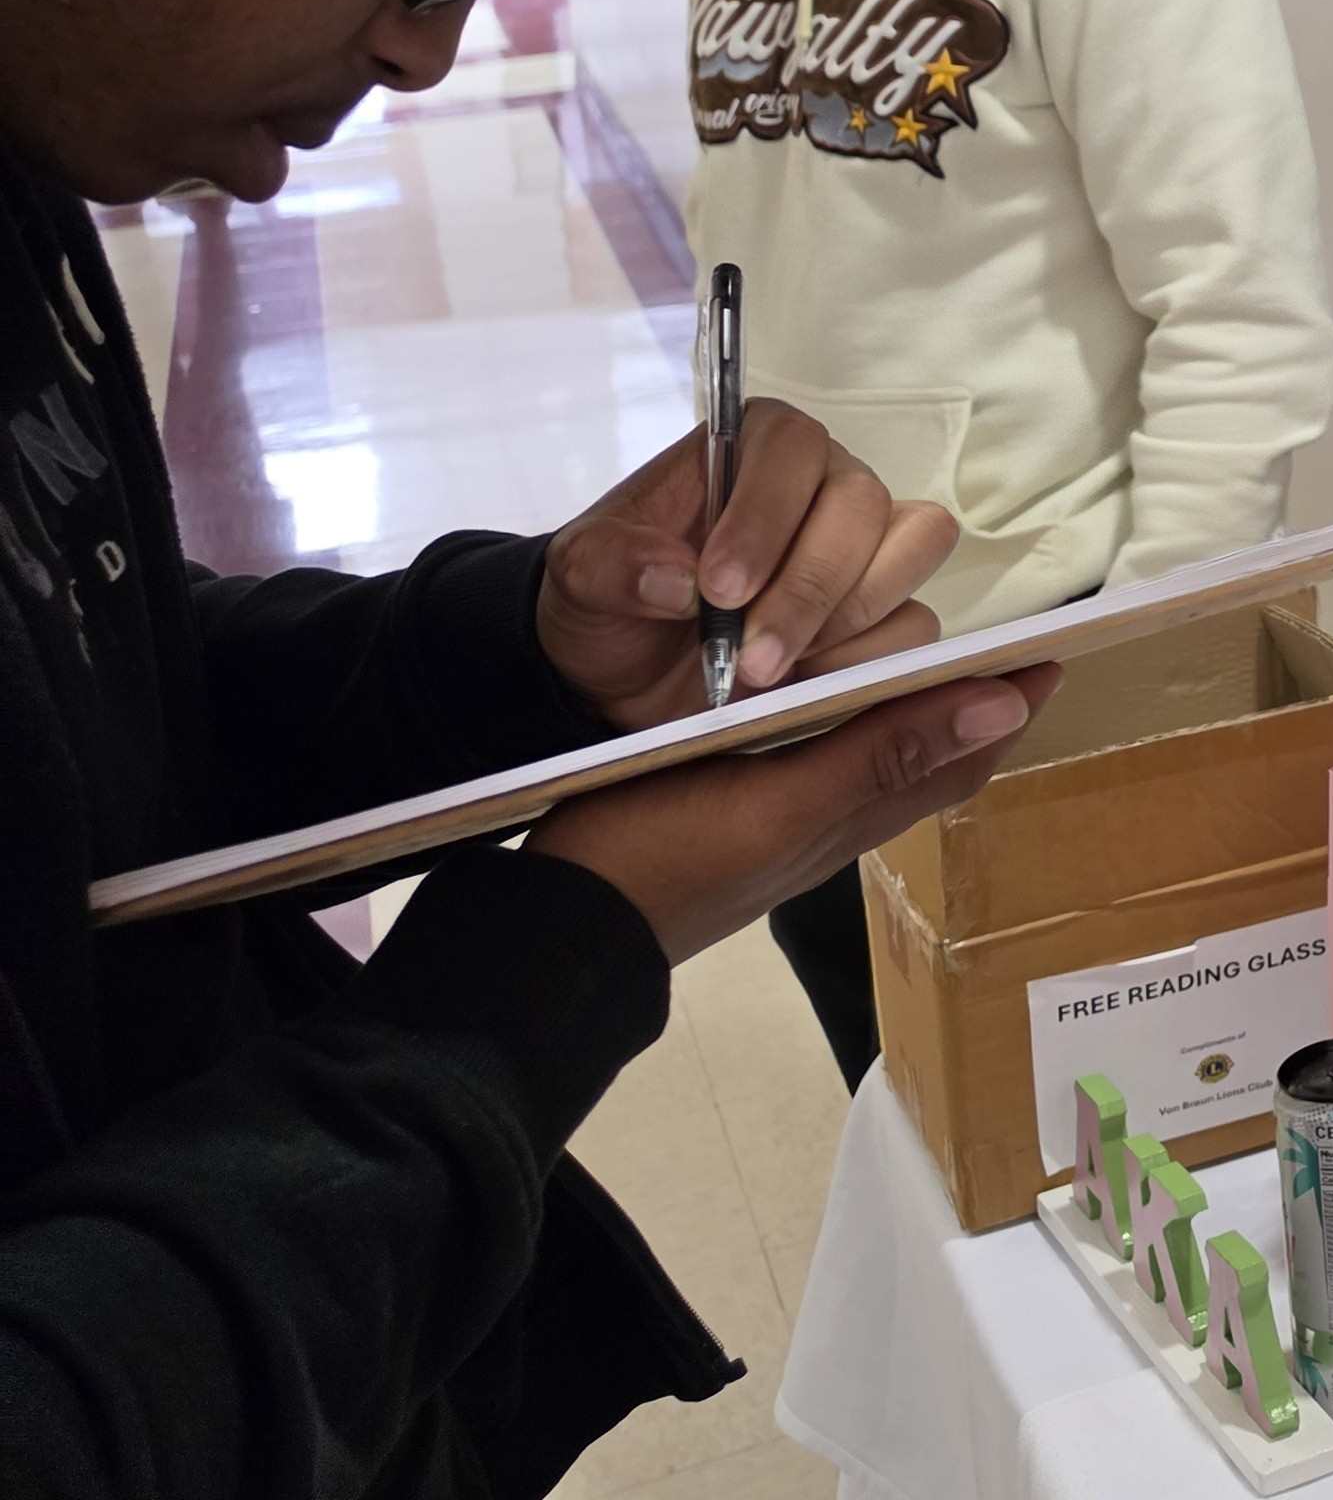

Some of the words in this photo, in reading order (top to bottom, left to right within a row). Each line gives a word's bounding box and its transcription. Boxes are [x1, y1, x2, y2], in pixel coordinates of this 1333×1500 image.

[1057, 991, 1121, 1023] FREE
[1128, 962, 1241, 1005] READING
[1216, 1087, 1246, 1102] Lions
[1247, 1079, 1274, 1093] Club
[1073, 1072, 1300, 1440] AKA
